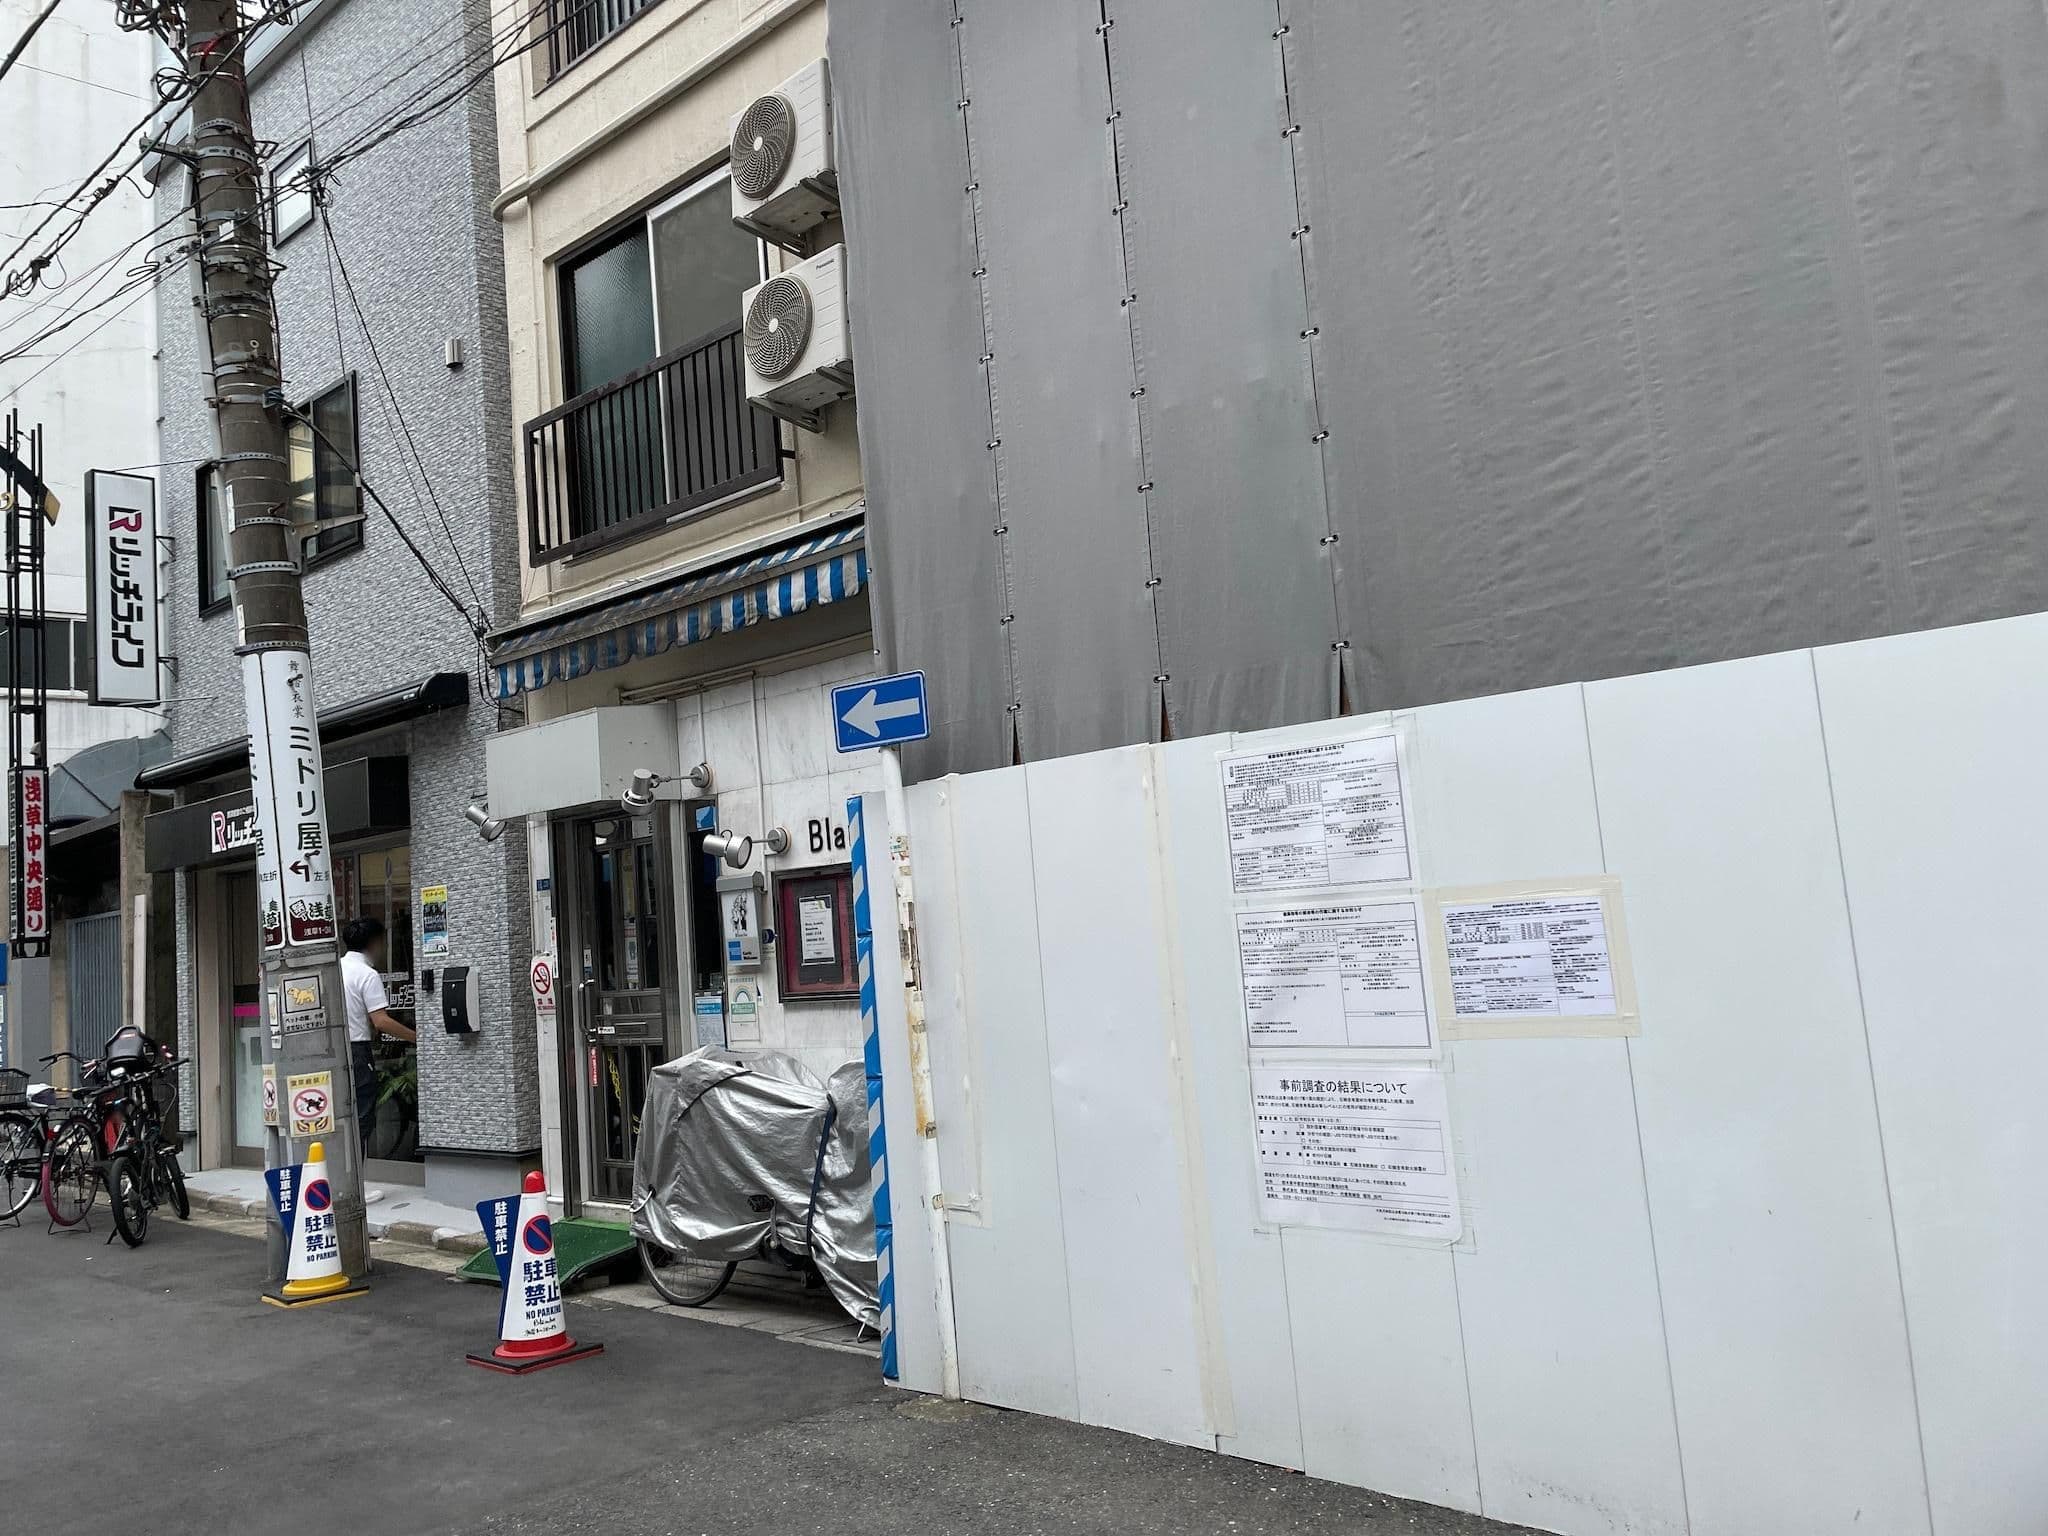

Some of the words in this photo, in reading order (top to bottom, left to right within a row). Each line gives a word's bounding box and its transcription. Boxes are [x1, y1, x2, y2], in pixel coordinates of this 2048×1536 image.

[290, 726, 322, 850] ミドリ屋
[227, 816, 257, 849] リッチ
[808, 817, 850, 853] Bla
[25, 776, 43, 932] 浅草中央通り
[1279, 1079, 1408, 1095] 事前調査の結果について
[279, 1168, 292, 1212] 駐車禁止
[305, 1213, 335, 1233] 駐車
[494, 1202, 508, 1256] 駐車禁止
[305, 1234, 337, 1252] 禁止
[306, 1254, 315, 1262] NO
[523, 1257, 559, 1282] 駐車
[525, 1283, 561, 1307] 禁止
[526, 1311, 536, 1319] NO
